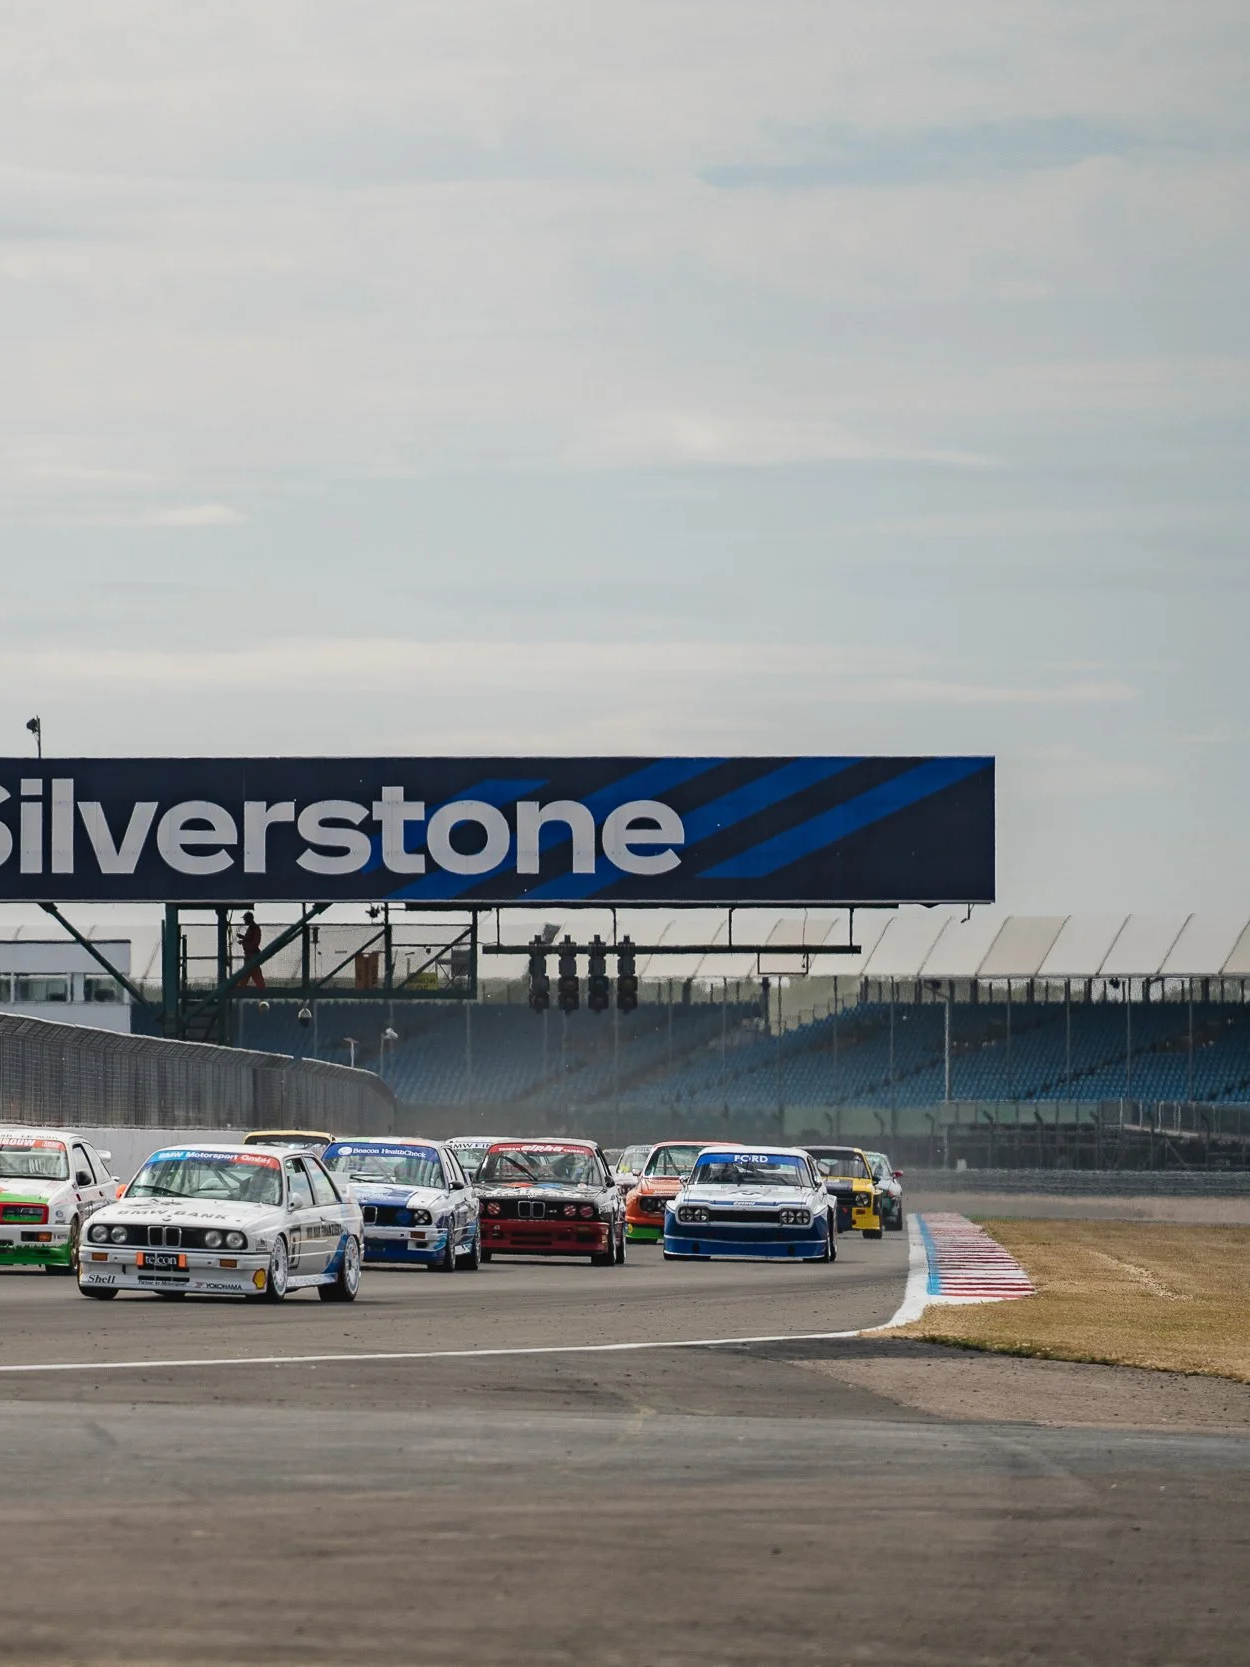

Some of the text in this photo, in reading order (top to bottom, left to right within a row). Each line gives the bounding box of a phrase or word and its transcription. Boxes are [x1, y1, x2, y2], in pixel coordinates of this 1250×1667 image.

[158, 1151, 272, 1164] BMW Motorsport GmbH
[381, 1149, 427, 1158] HealthCheck
[734, 1154, 769, 1163] FORD
[173, 1210, 231, 1220] BANK
[88, 1274, 116, 1284] Shell
[206, 1282, 243, 1291] YOKOHAMA
